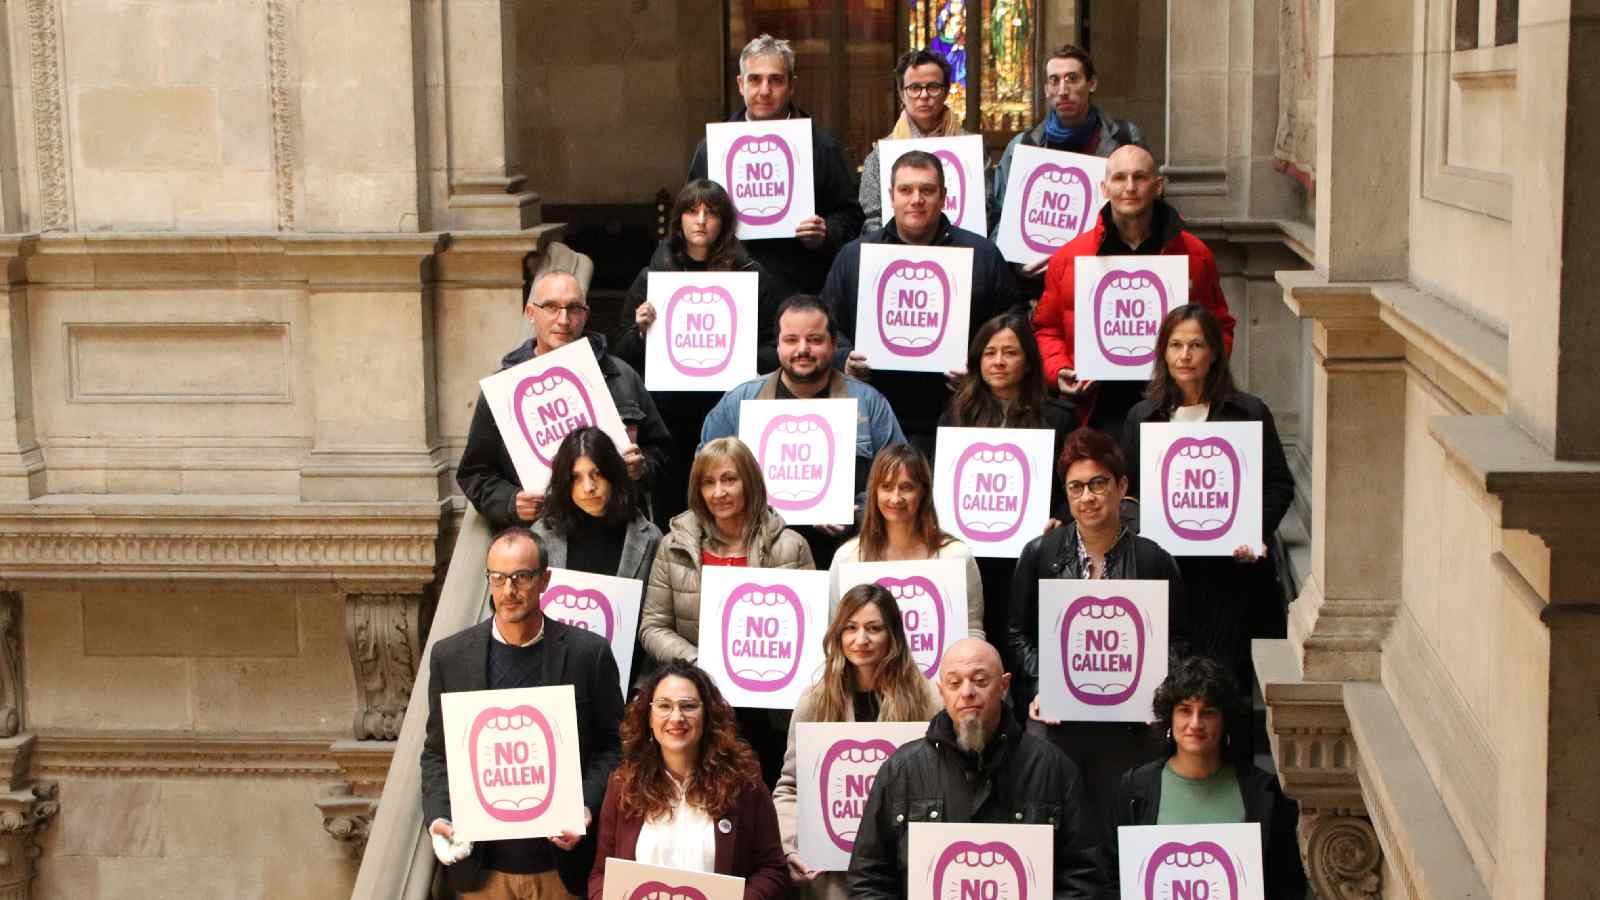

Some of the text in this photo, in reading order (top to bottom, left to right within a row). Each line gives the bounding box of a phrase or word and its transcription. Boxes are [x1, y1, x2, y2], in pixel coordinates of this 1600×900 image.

[746, 162, 773, 179] NO
[736, 181, 785, 198] CALLEM
[1042, 190, 1069, 211] NO
[1028, 209, 1076, 230] CALLEM
[898, 289, 927, 308] NO
[1116, 299, 1144, 317] NO
[686, 313, 714, 331] NO
[886, 310, 938, 327] CALLEM
[1103, 320, 1156, 336] CALLEM
[675, 333, 726, 348] CALLEM
[538, 398, 569, 424] NO
[781, 443, 811, 462] NO
[768, 464, 822, 480] CALLEM
[1184, 469, 1215, 489] NO
[976, 473, 1006, 492] NO
[963, 494, 1017, 512] CALLEM
[1172, 491, 1228, 508] CALLEM
[746, 617, 779, 637] NO
[902, 610, 919, 631] O
[732, 640, 791, 658] CALLEM
[1086, 630, 1118, 651] NO
[1072, 653, 1132, 671] CALLEM
[494, 741, 528, 763] NO
[483, 766, 545, 786] CALLEM
[961, 879, 997, 900] NO
[1172, 879, 1209, 900] NO
